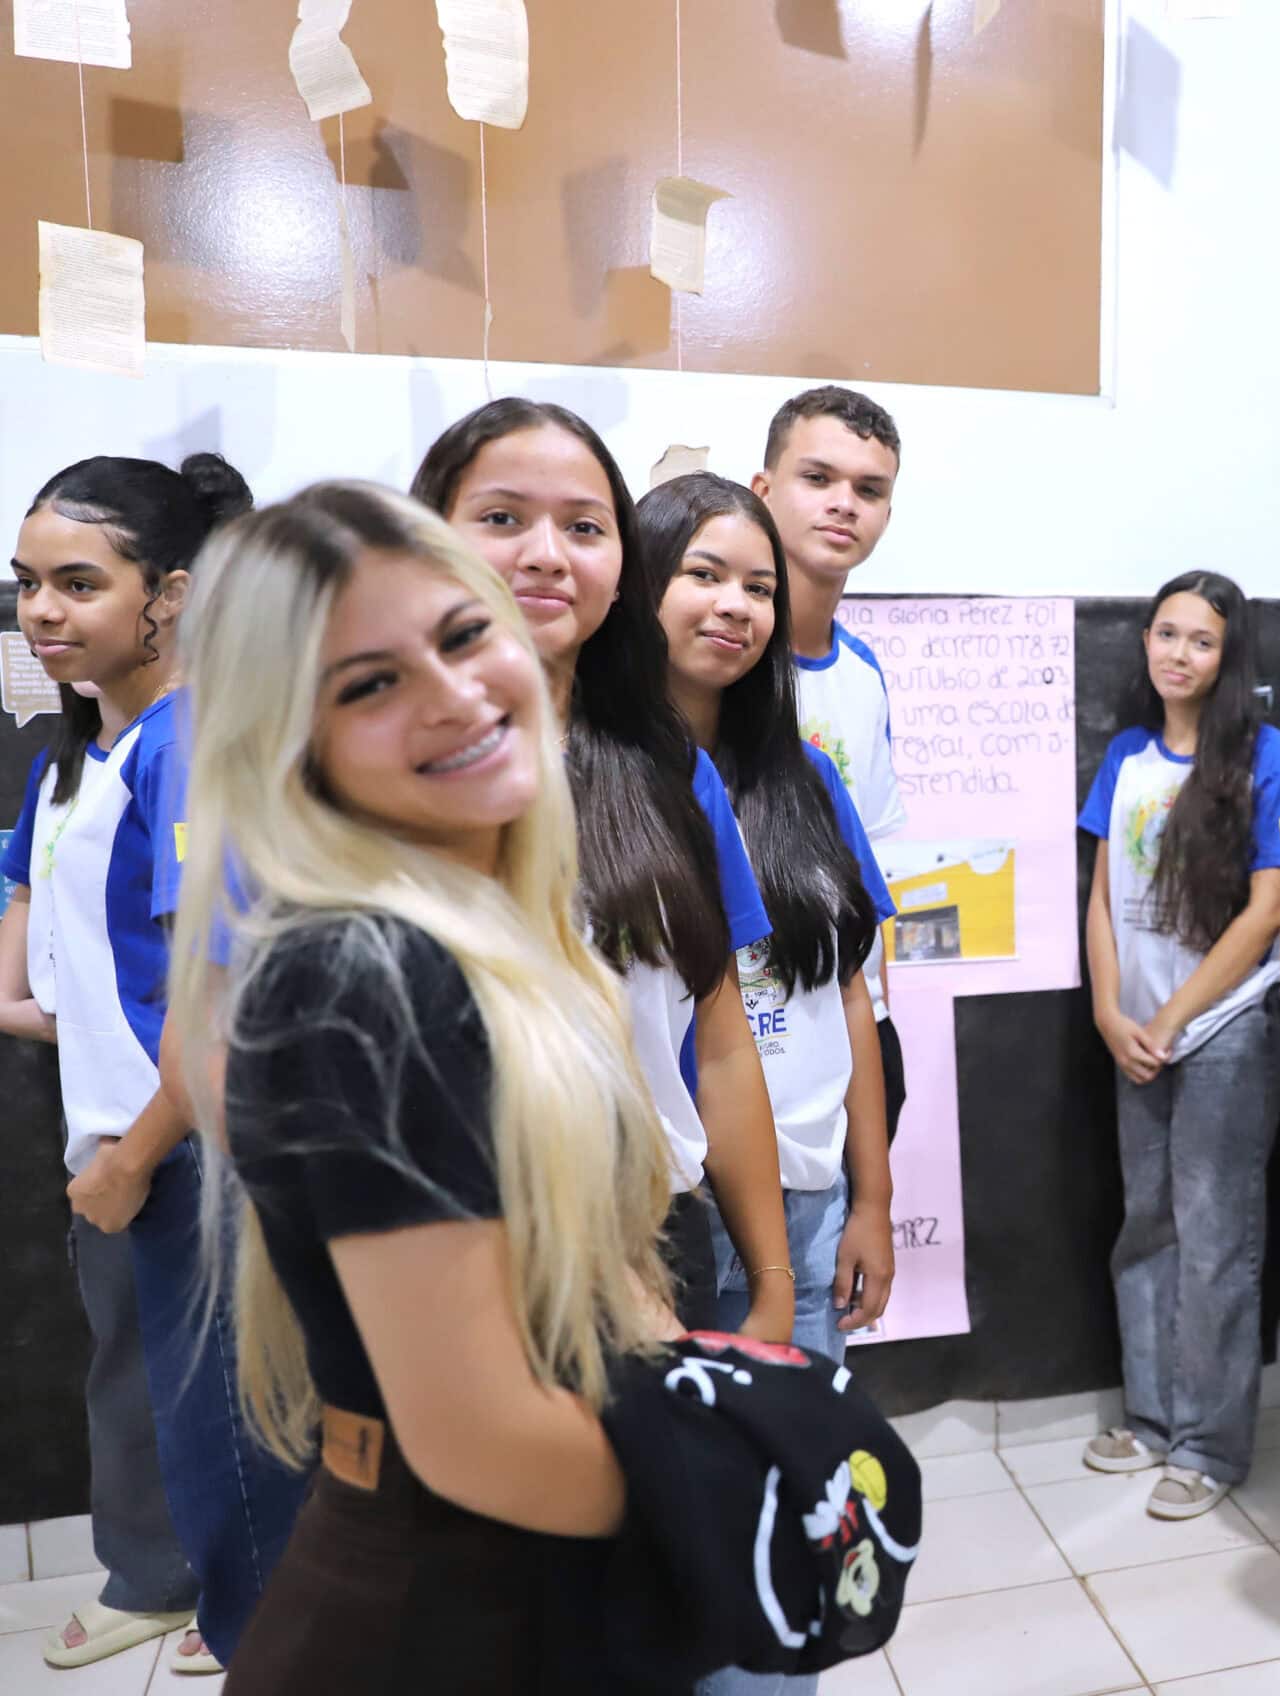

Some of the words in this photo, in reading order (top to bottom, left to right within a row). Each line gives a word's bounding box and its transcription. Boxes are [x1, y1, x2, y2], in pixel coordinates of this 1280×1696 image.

[902, 702, 960, 726] uma
[967, 698, 1050, 726] escola
[980, 731, 1042, 758] com
